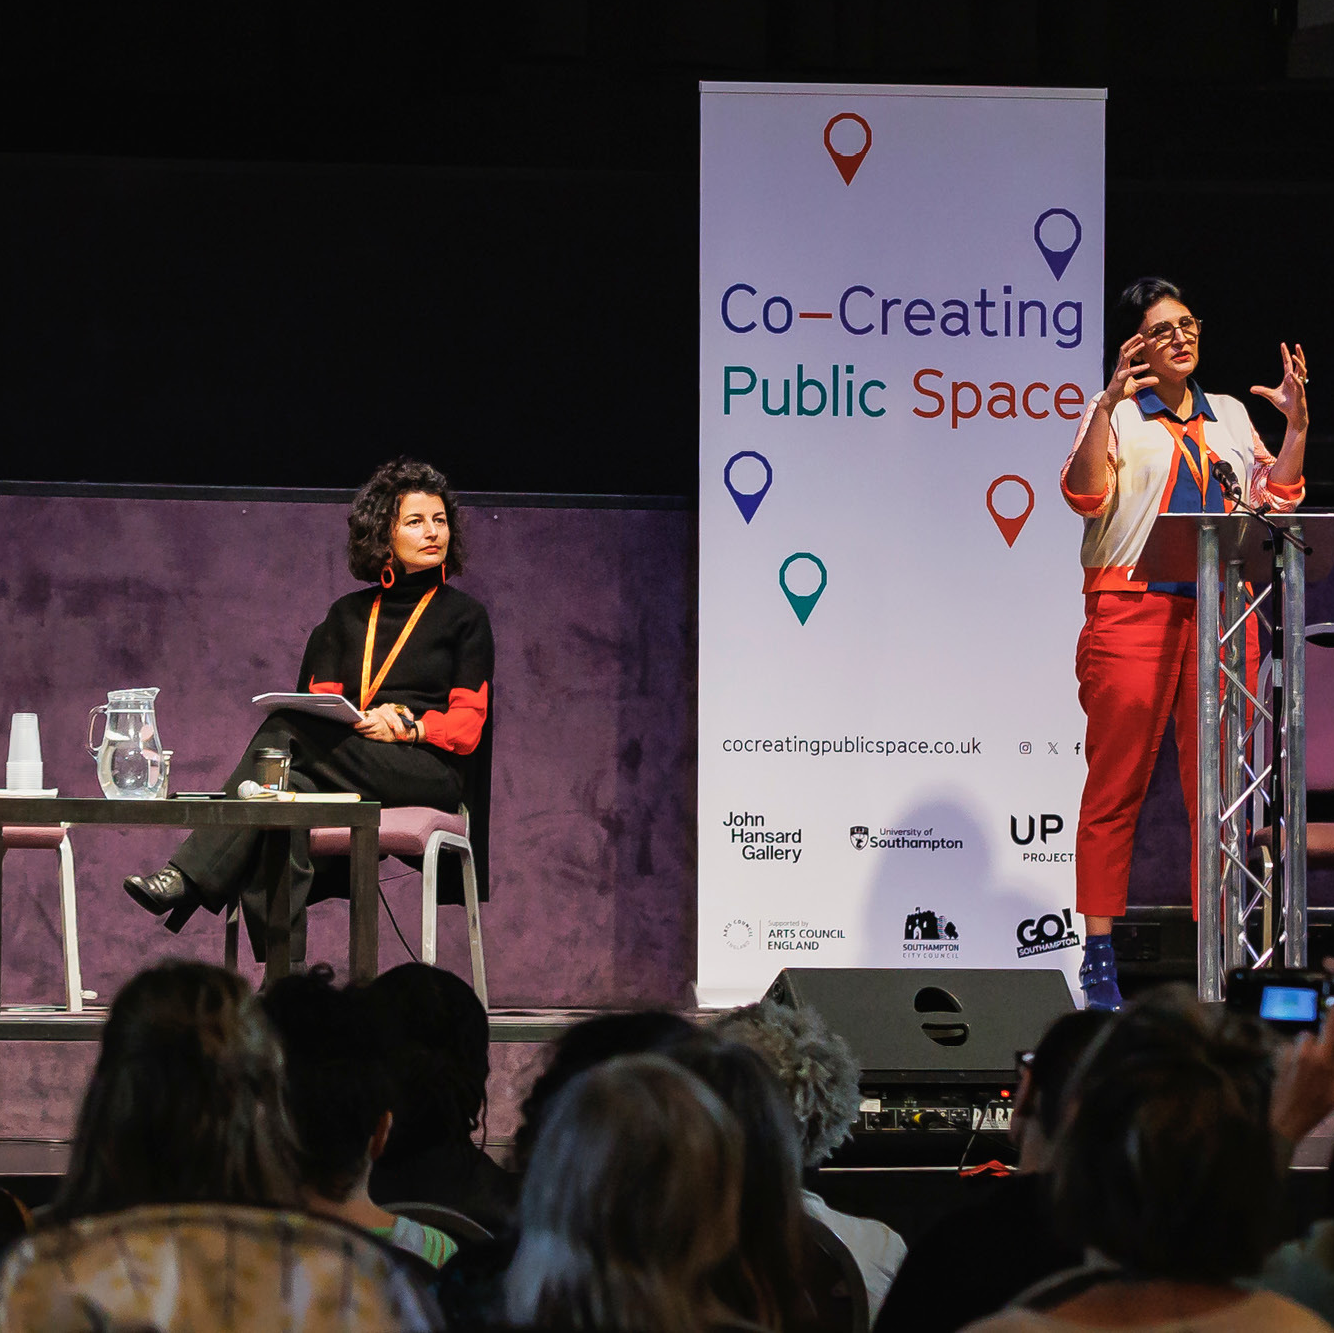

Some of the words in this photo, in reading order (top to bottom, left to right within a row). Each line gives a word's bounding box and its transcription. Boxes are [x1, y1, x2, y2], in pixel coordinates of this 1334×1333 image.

[723, 363, 887, 418] Public
[912, 368, 1085, 430] Space
[722, 735, 982, 757] cocreatingpublicspace.co.uk
[722, 811, 765, 827] John
[731, 827, 802, 844] Hansard
[879, 827, 922, 838] University
[923, 827, 934, 837] of
[1010, 813, 1064, 846] UP
[869, 836, 963, 852] Southampton
[741, 844, 802, 864] Gallery
[1023, 853, 1076, 862] PROJECT
[768, 929, 796, 939] ARTS
[799, 929, 846, 939] COUNCIL
[1017, 908, 1074, 947] GO!
[767, 940, 820, 951] ENGLAND
[1019, 937, 1078, 956] SOUTHAMPTON
